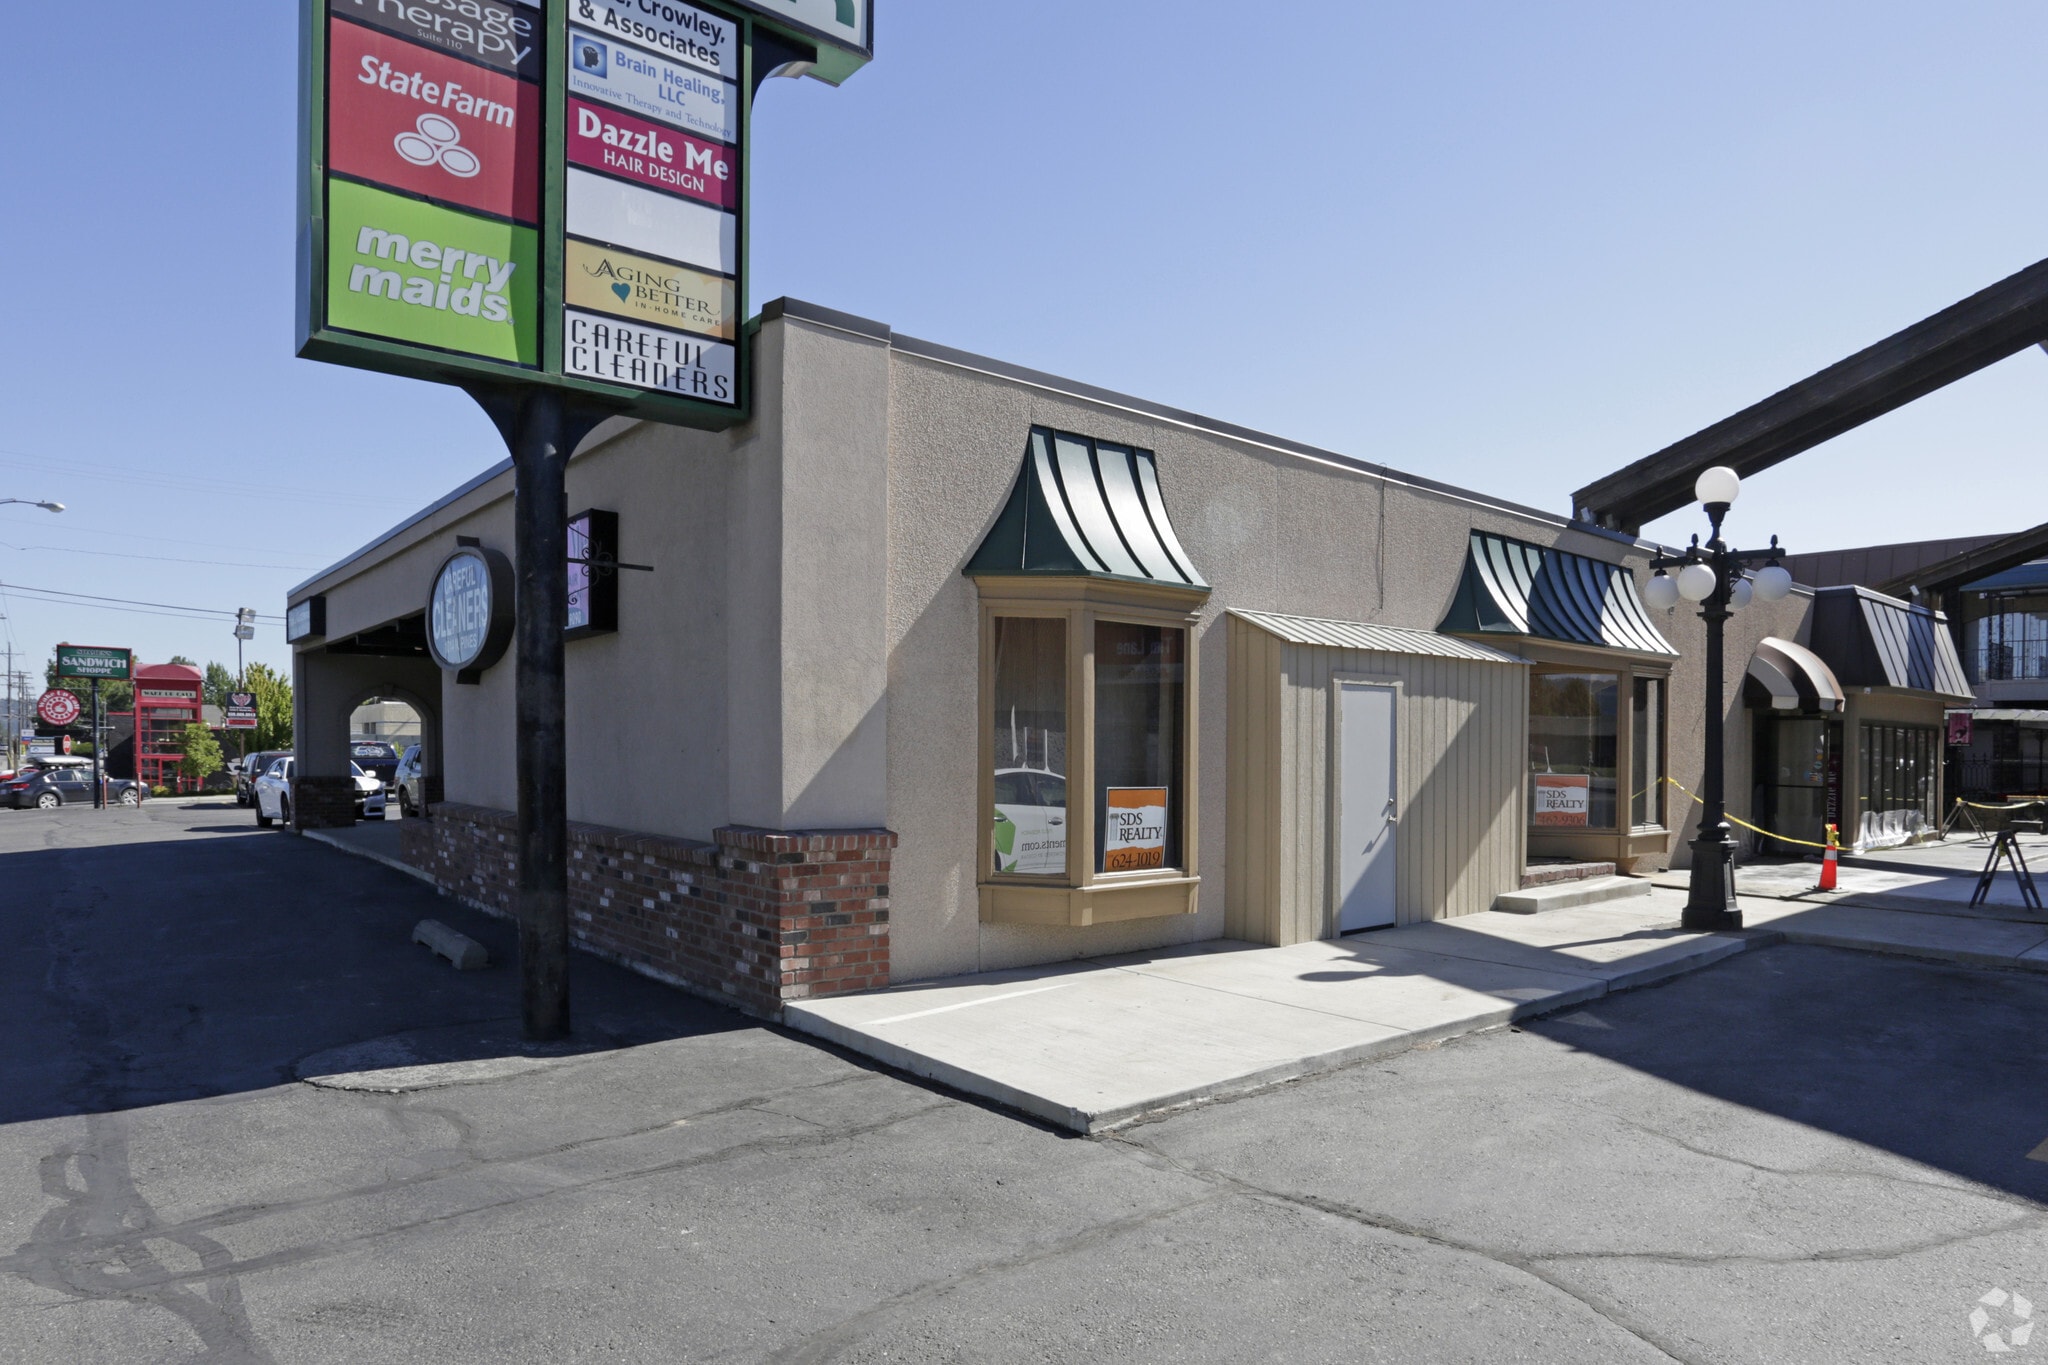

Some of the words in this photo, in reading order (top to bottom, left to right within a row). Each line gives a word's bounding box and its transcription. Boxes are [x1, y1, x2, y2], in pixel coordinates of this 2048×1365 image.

[354, 0, 532, 65] herapy
[417, 28, 443, 43] Suite
[445, 38, 463, 50] 110
[578, 0, 596, 22] &
[604, 8, 720, 66] Associates
[638, 0, 725, 46] Crowley,
[615, 51, 657, 78] Brain
[664, 67, 725, 104] Healing,
[573, 75, 622, 100] Innovative
[625, 93, 662, 114] Therapy
[665, 107, 682, 120] and
[685, 112, 732, 138] Technology
[658, 84, 686, 106] LLC
[578, 107, 673, 163] Dazzle
[684, 141, 729, 181] Me
[603, 149, 644, 175] HAIR
[649, 162, 705, 193] DESIGN
[356, 226, 516, 293] merry
[583, 258, 681, 293] AGING
[635, 284, 721, 316] BETTER
[692, 314, 720, 327] CARE
[571, 319, 706, 370] CAREFUL
[572, 346, 728, 399] CLEANERS
[444, 565, 476, 595] CAREFUL
[432, 585, 488, 641] CLEANERS
[62, 656, 127, 669] SANDWICH
[76, 666, 112, 674] SHOPPE
[39, 692, 55, 708] Wake
[56, 690, 69, 698] Up
[1546, 790, 1567, 799] SDS
[1546, 800, 1584, 809] REALTY
[1119, 812, 1143, 826] SDS
[1119, 826, 1162, 843] REALTY
[1111, 851, 1160, 869] 624-1019
